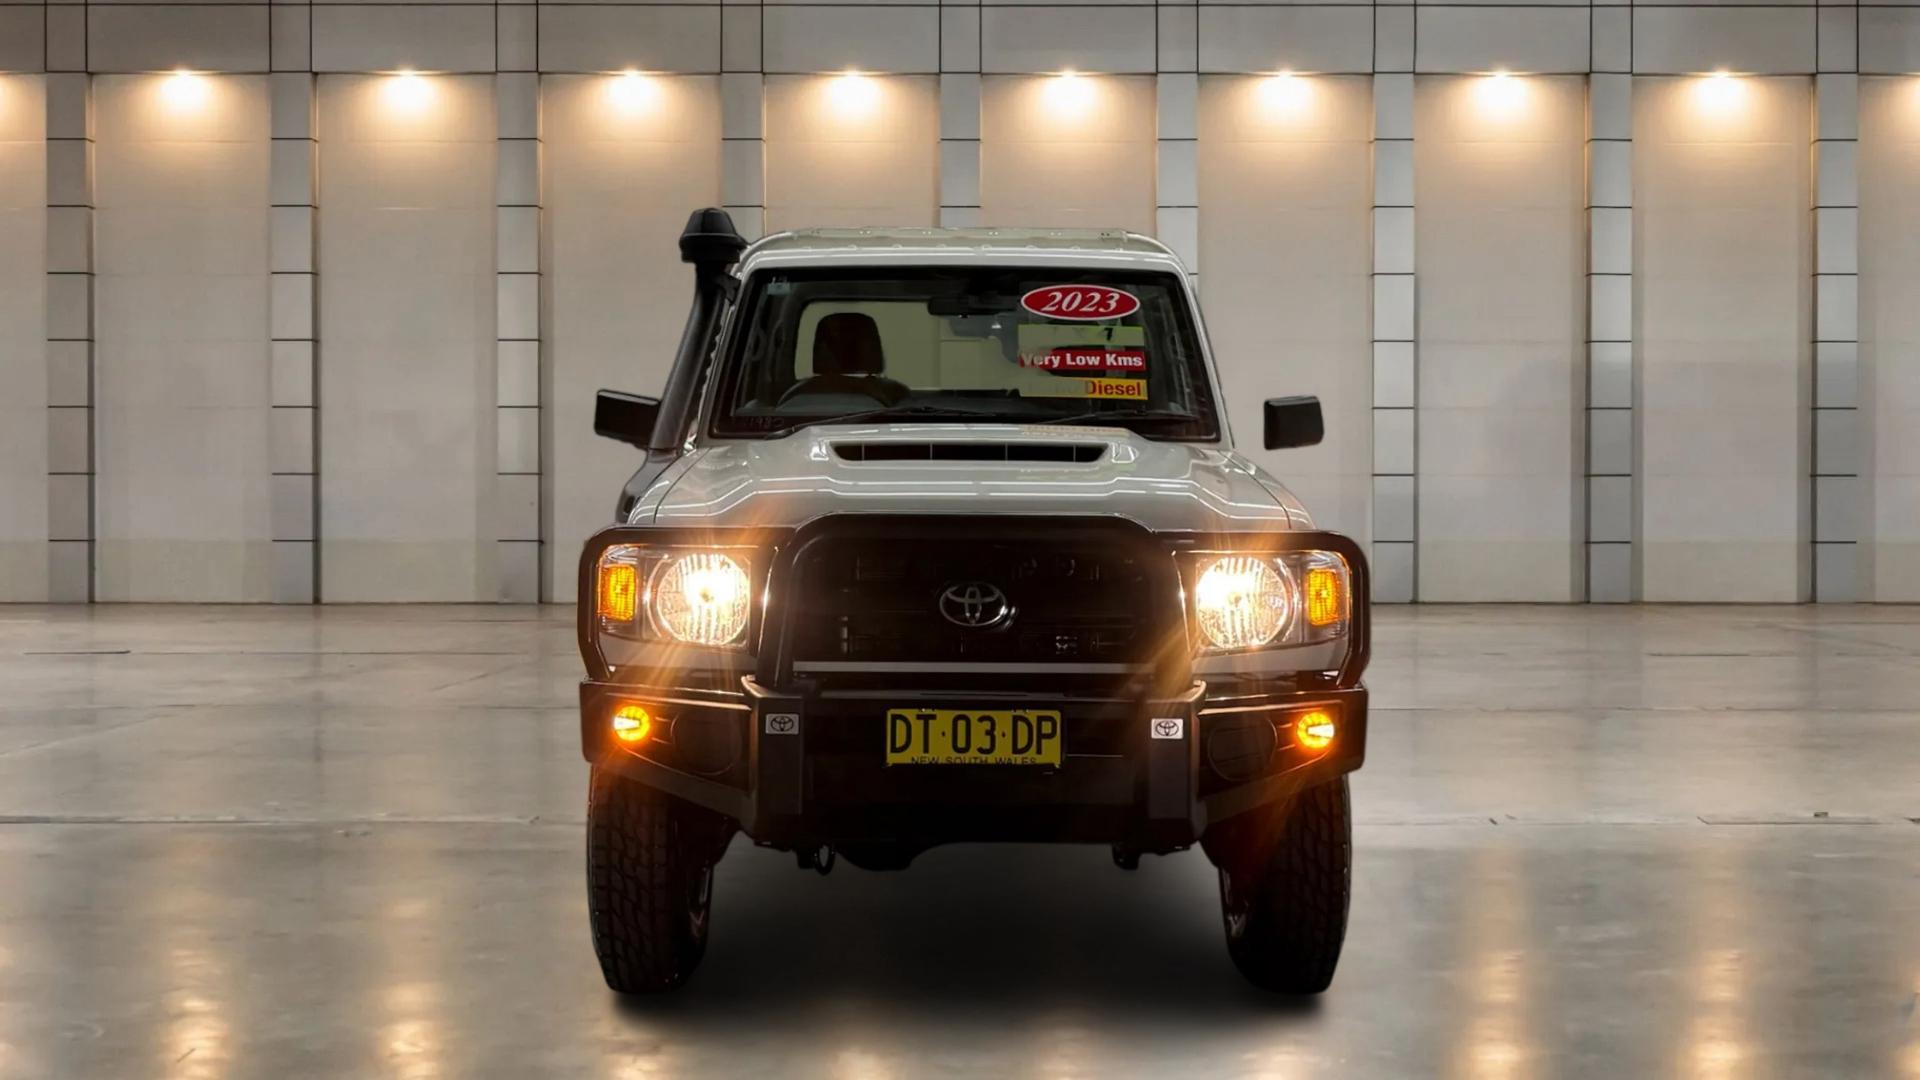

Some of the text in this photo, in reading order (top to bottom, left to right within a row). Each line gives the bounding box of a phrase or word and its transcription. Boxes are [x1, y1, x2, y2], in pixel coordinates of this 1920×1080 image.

[1041, 291, 1121, 313] 2023
[1022, 352, 1143, 368] Very Low Kms
[1085, 381, 1141, 396] Diesel
[911, 756, 940, 765] NEW
[946, 756, 989, 765] SOUTH
